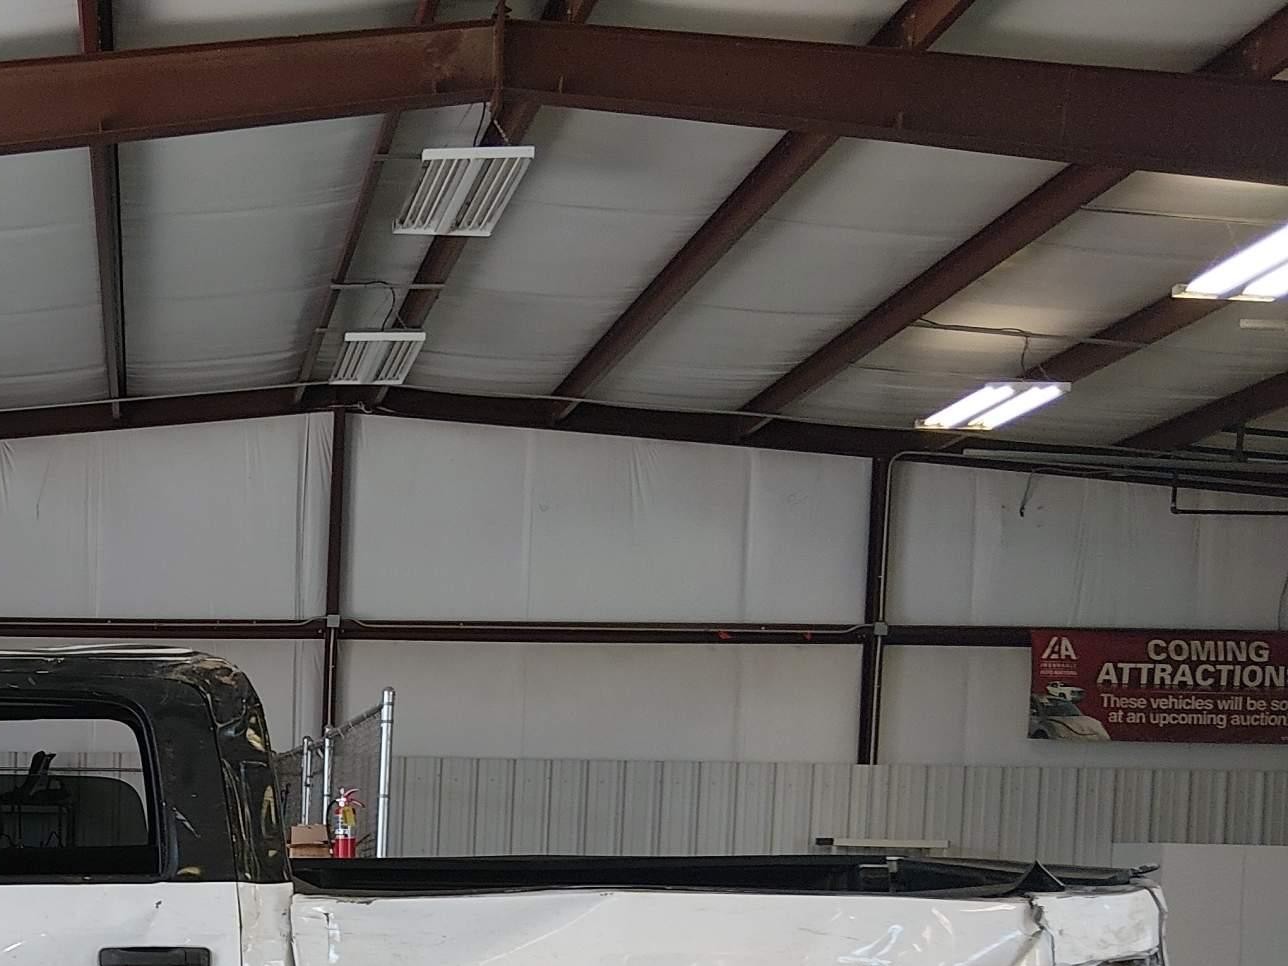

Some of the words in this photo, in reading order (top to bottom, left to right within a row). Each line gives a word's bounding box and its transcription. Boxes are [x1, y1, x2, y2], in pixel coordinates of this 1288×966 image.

[1147, 639, 1270, 662] COMING
[1096, 662, 1288, 687] ATTRACTION
[1099, 693, 1147, 709] These
[1150, 694, 1214, 710] vehicles
[1217, 696, 1243, 711] will
[1246, 696, 1268, 711] be
[1108, 709, 1124, 723] at
[1126, 711, 1146, 724] an
[1149, 710, 1227, 729] upcoming
[1230, 711, 1288, 727] auction
